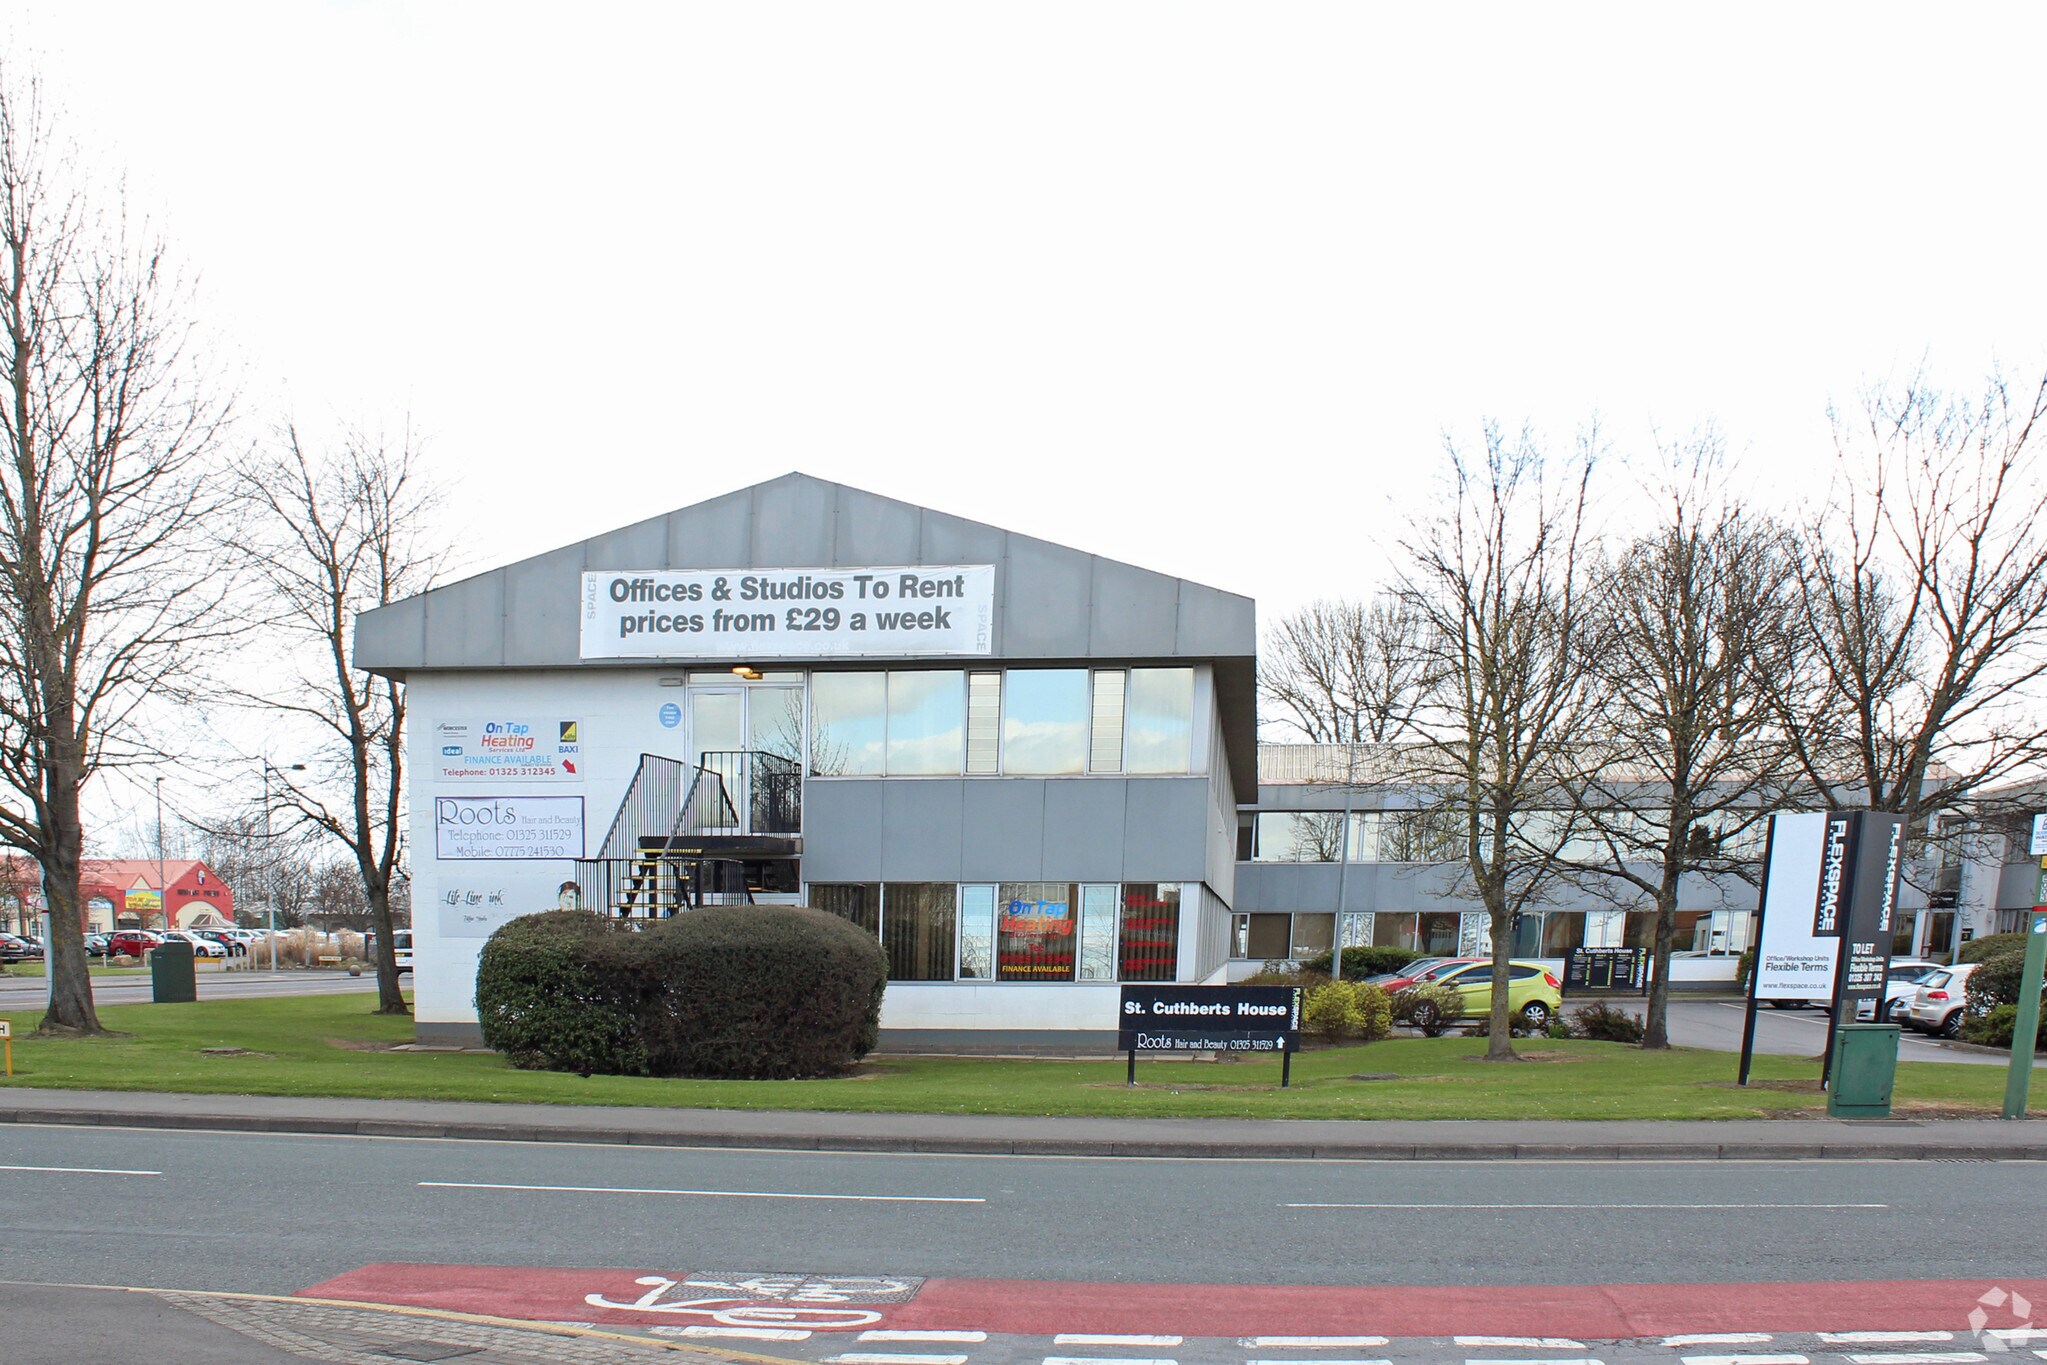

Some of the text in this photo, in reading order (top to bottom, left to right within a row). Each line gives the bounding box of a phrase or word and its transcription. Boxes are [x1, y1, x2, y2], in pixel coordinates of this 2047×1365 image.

[609, 574, 965, 602] Offices & Studios To Rent
[587, 574, 597, 619] SPACE
[620, 606, 951, 638] prices from £29 a week
[976, 604, 988, 652] SPACE
[485, 722, 529, 736] On Tap
[481, 735, 535, 750] Heating
[558, 746, 579, 754] BAXI
[444, 747, 461, 755] ideal
[464, 755, 552, 765] FINANCE AVAILABLE
[443, 767, 556, 777] Telephone: 01325 312345
[438, 799, 581, 827] Roots Hair and Beauty
[448, 829, 572, 845] Telephone: 01325 311529
[456, 846, 565, 857] Mobile: 07775 241530
[1822, 820, 1847, 931] FLEXSPACE
[1880, 823, 1902, 932] FLEXSPACE
[1009, 899, 1068, 919] On Tap
[1001, 916, 1073, 936] Heating
[1852, 943, 1875, 954] TO LET
[1002, 965, 1071, 973] FINANCE AVAILABLE
[1765, 962, 1829, 971] Flexible Terms
[1763, 982, 1827, 990] www.flexspace.co.uk
[1125, 1002, 1287, 1016] St. Cuthberts House
[1137, 1033, 1274, 1051] Roots Hair and Beauty 01325 311529
